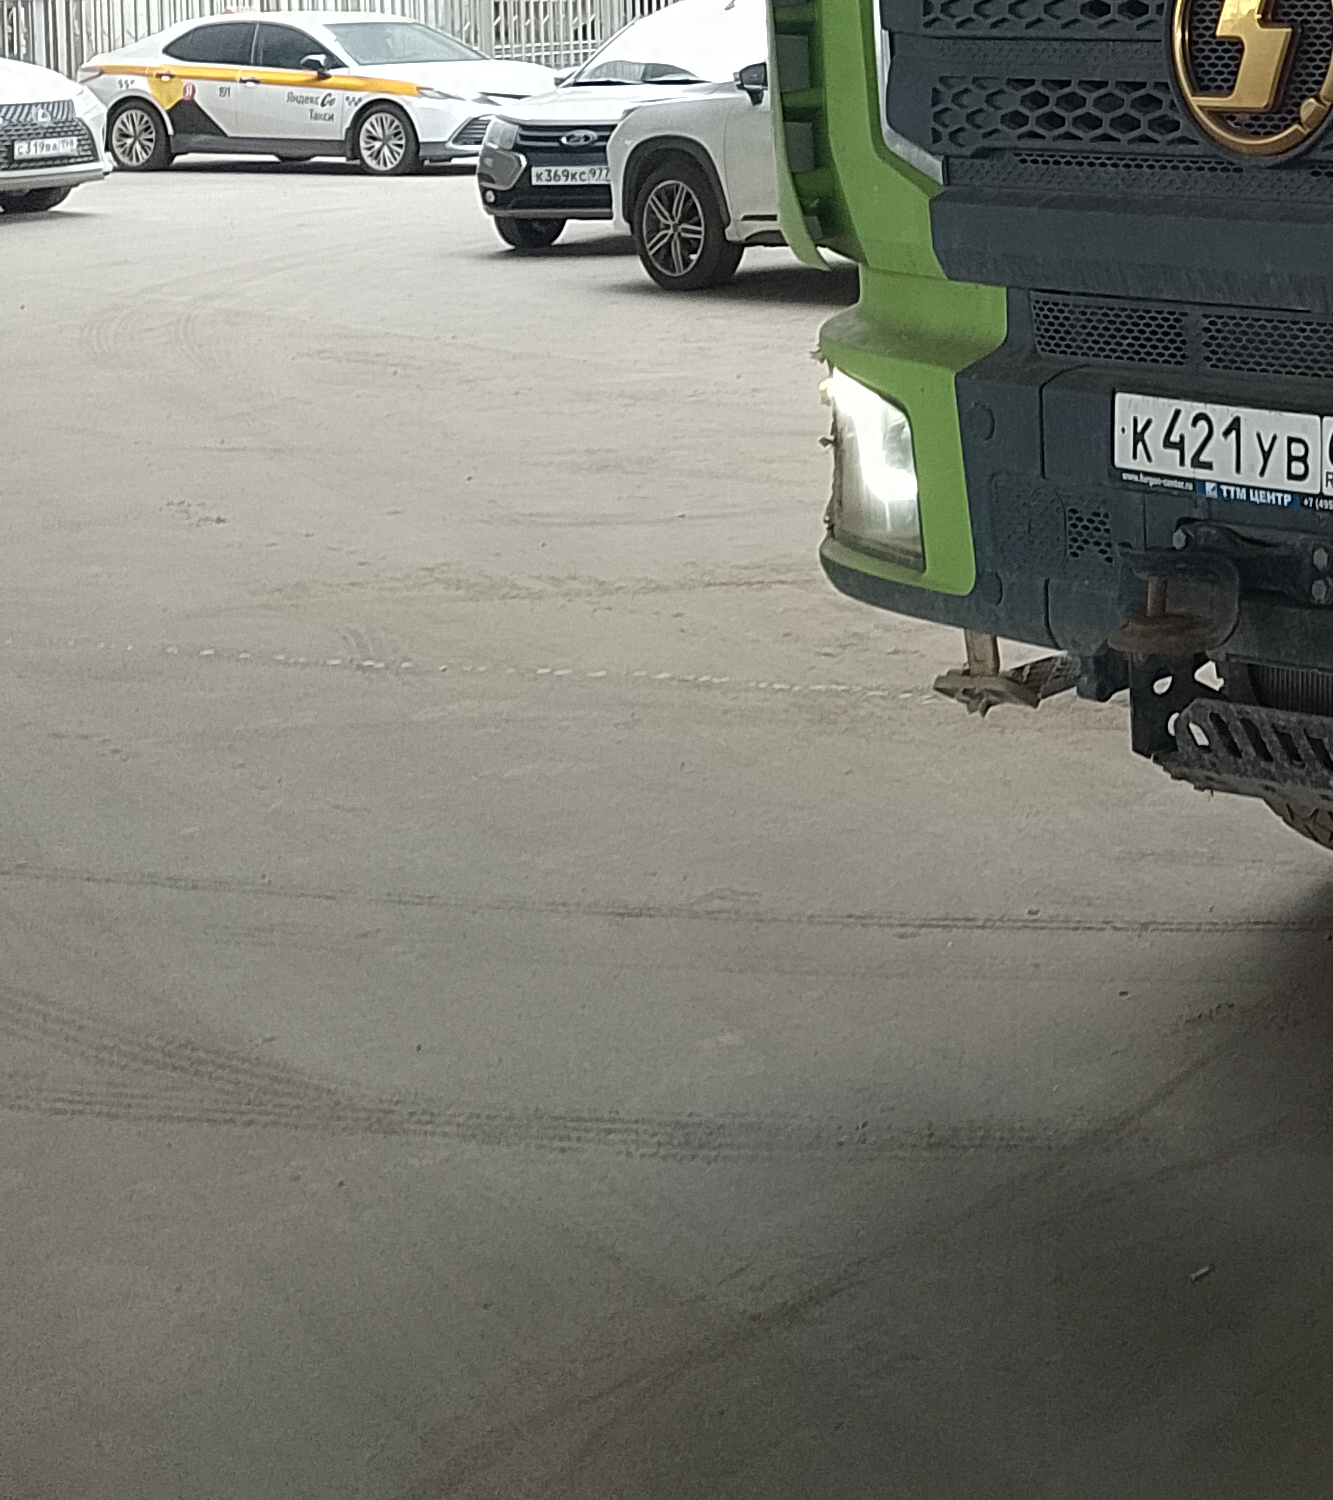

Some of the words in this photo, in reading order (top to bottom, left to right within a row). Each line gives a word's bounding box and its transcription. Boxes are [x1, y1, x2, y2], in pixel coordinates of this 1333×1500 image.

[286, 91, 320, 105] Яндекс
[320, 92, 336, 108] Go
[309, 108, 335, 122] Такси
[535, 168, 587, 183] К369КС
[1131, 407, 1310, 482] К421УВ
[1219, 484, 1247, 500] ТТМ
[1249, 488, 1293, 506] ЦЕНТР
